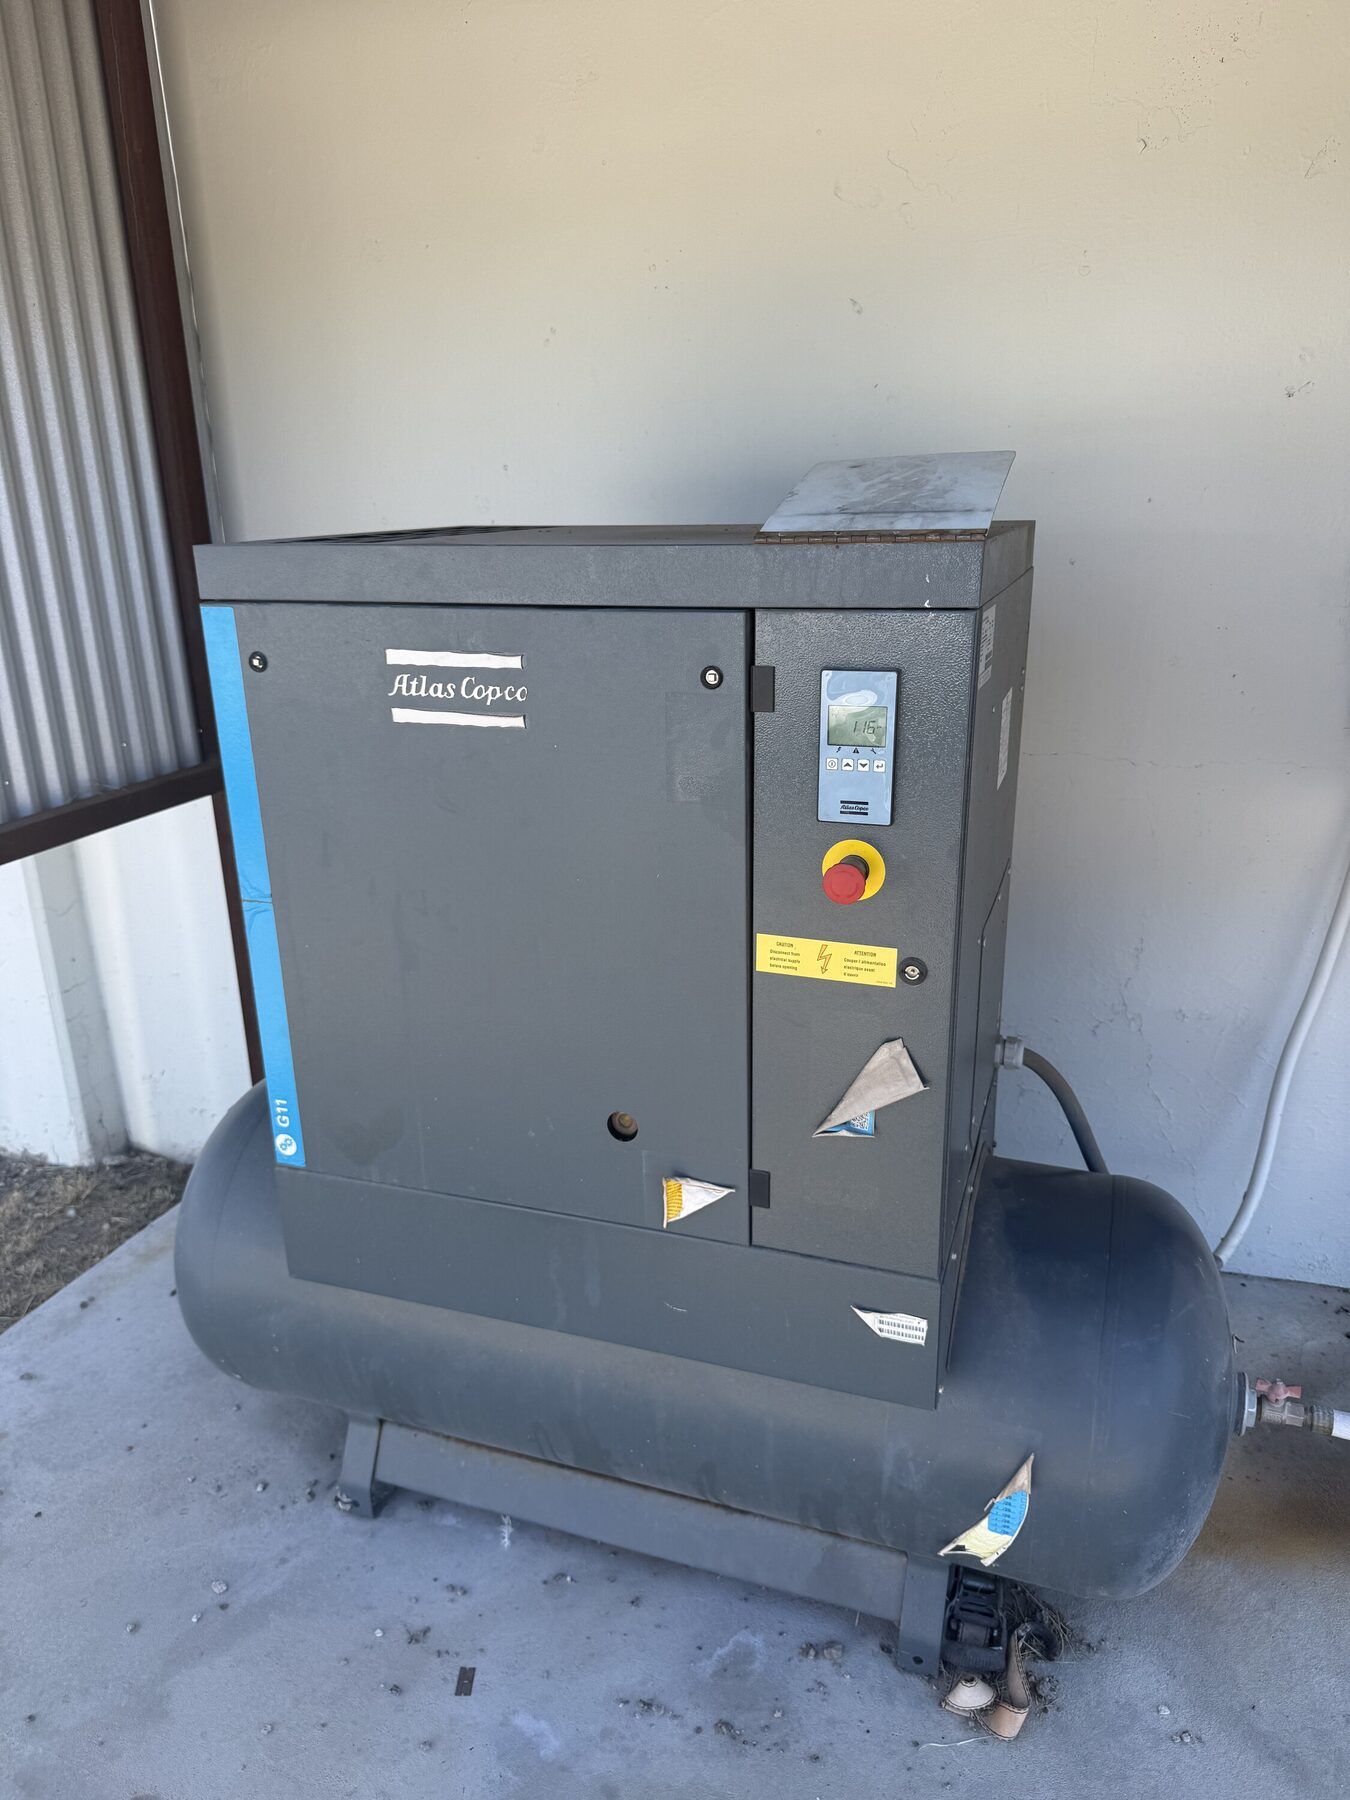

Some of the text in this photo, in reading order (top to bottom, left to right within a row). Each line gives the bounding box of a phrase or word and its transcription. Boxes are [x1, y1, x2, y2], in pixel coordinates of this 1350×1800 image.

[388, 673, 528, 706] Atlas Copco
[854, 950, 877, 958] ATTENTION
[275, 1099, 290, 1128] G11
